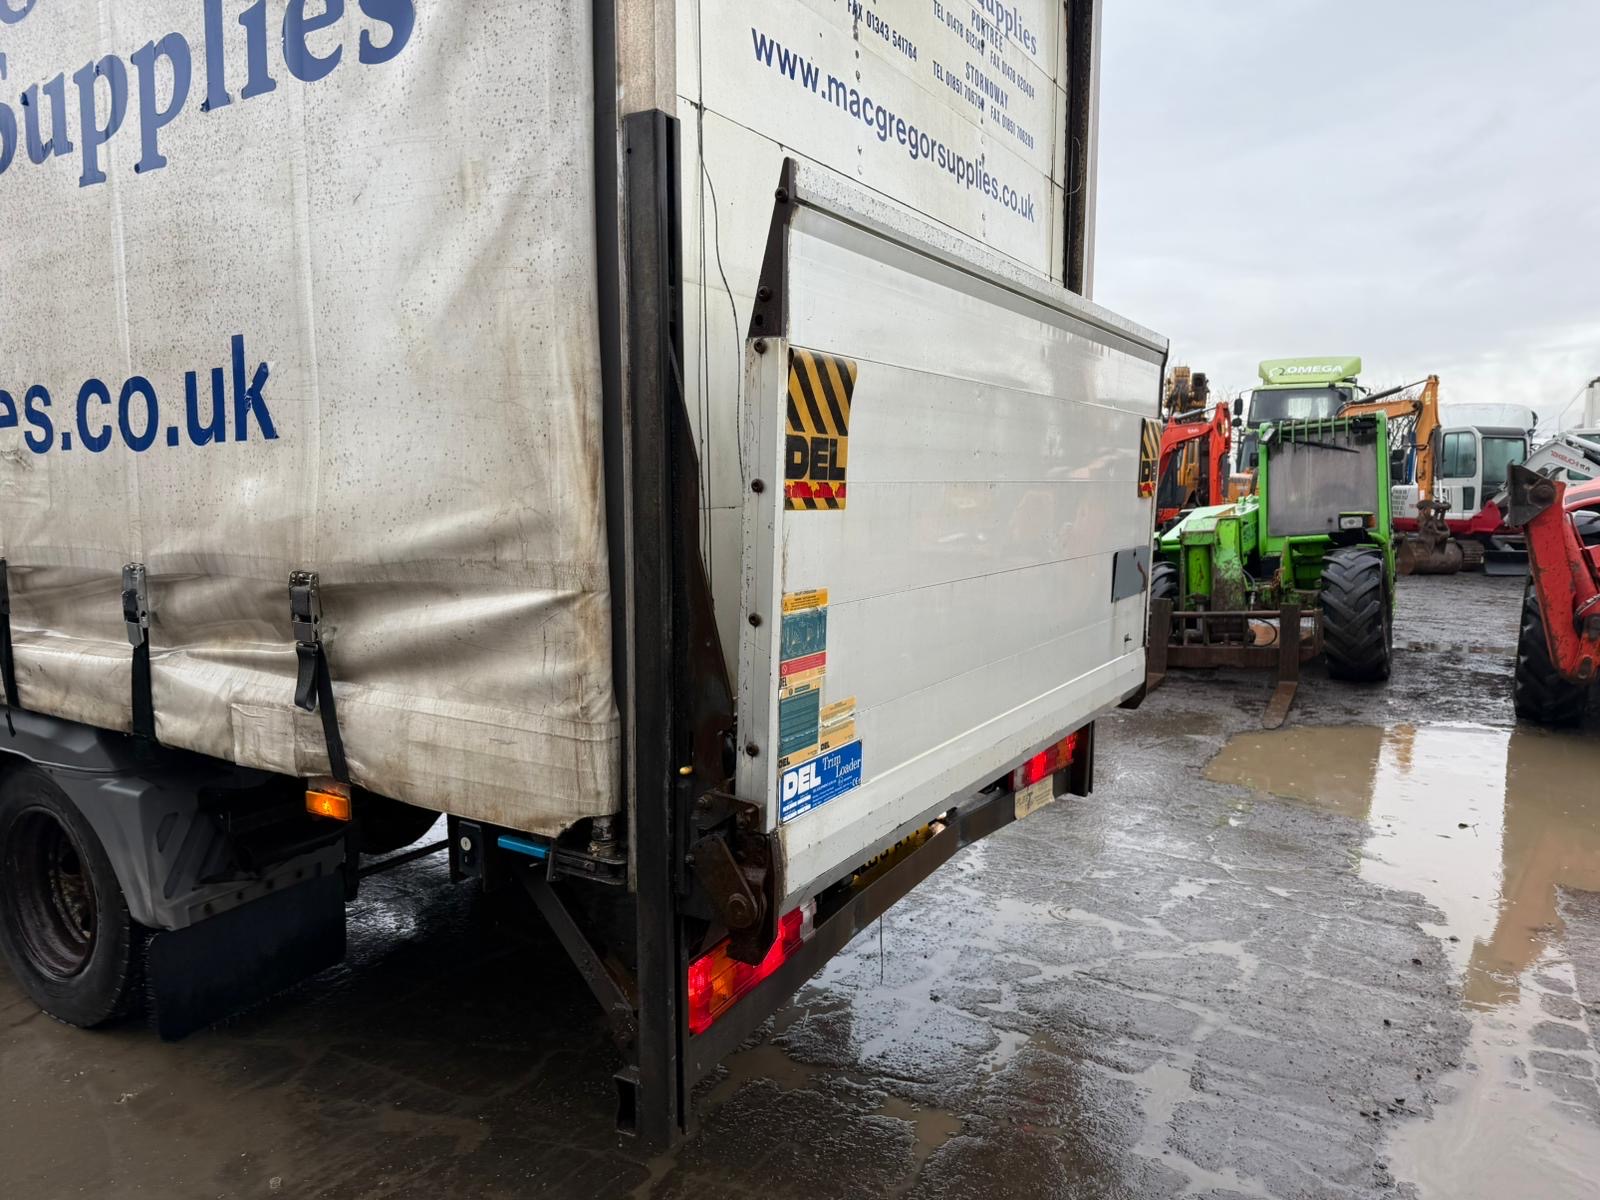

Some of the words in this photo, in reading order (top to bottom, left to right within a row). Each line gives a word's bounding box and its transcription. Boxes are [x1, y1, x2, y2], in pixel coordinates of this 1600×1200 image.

[866, 10, 889, 41] 01343
[892, 30, 917, 62] 541764
[933, 0, 944, 22] TEL
[990, 50, 1001, 70] FAX
[971, 9, 1003, 53] PORTREE
[977, 0, 1036, 55] upplies
[933, 60, 944, 81] TEL
[990, 105, 1001, 125] FAX
[965, 61, 1008, 110] STORNOWAY
[751, 27, 1034, 223] www.macgregorsupplies.co.uk
[1287, 364, 1343, 375] OMEGA
[785, 434, 846, 481] DEL
[783, 762, 822, 802] DEL
[822, 752, 841, 771] Trim
[836, 757, 861, 778] Loader
